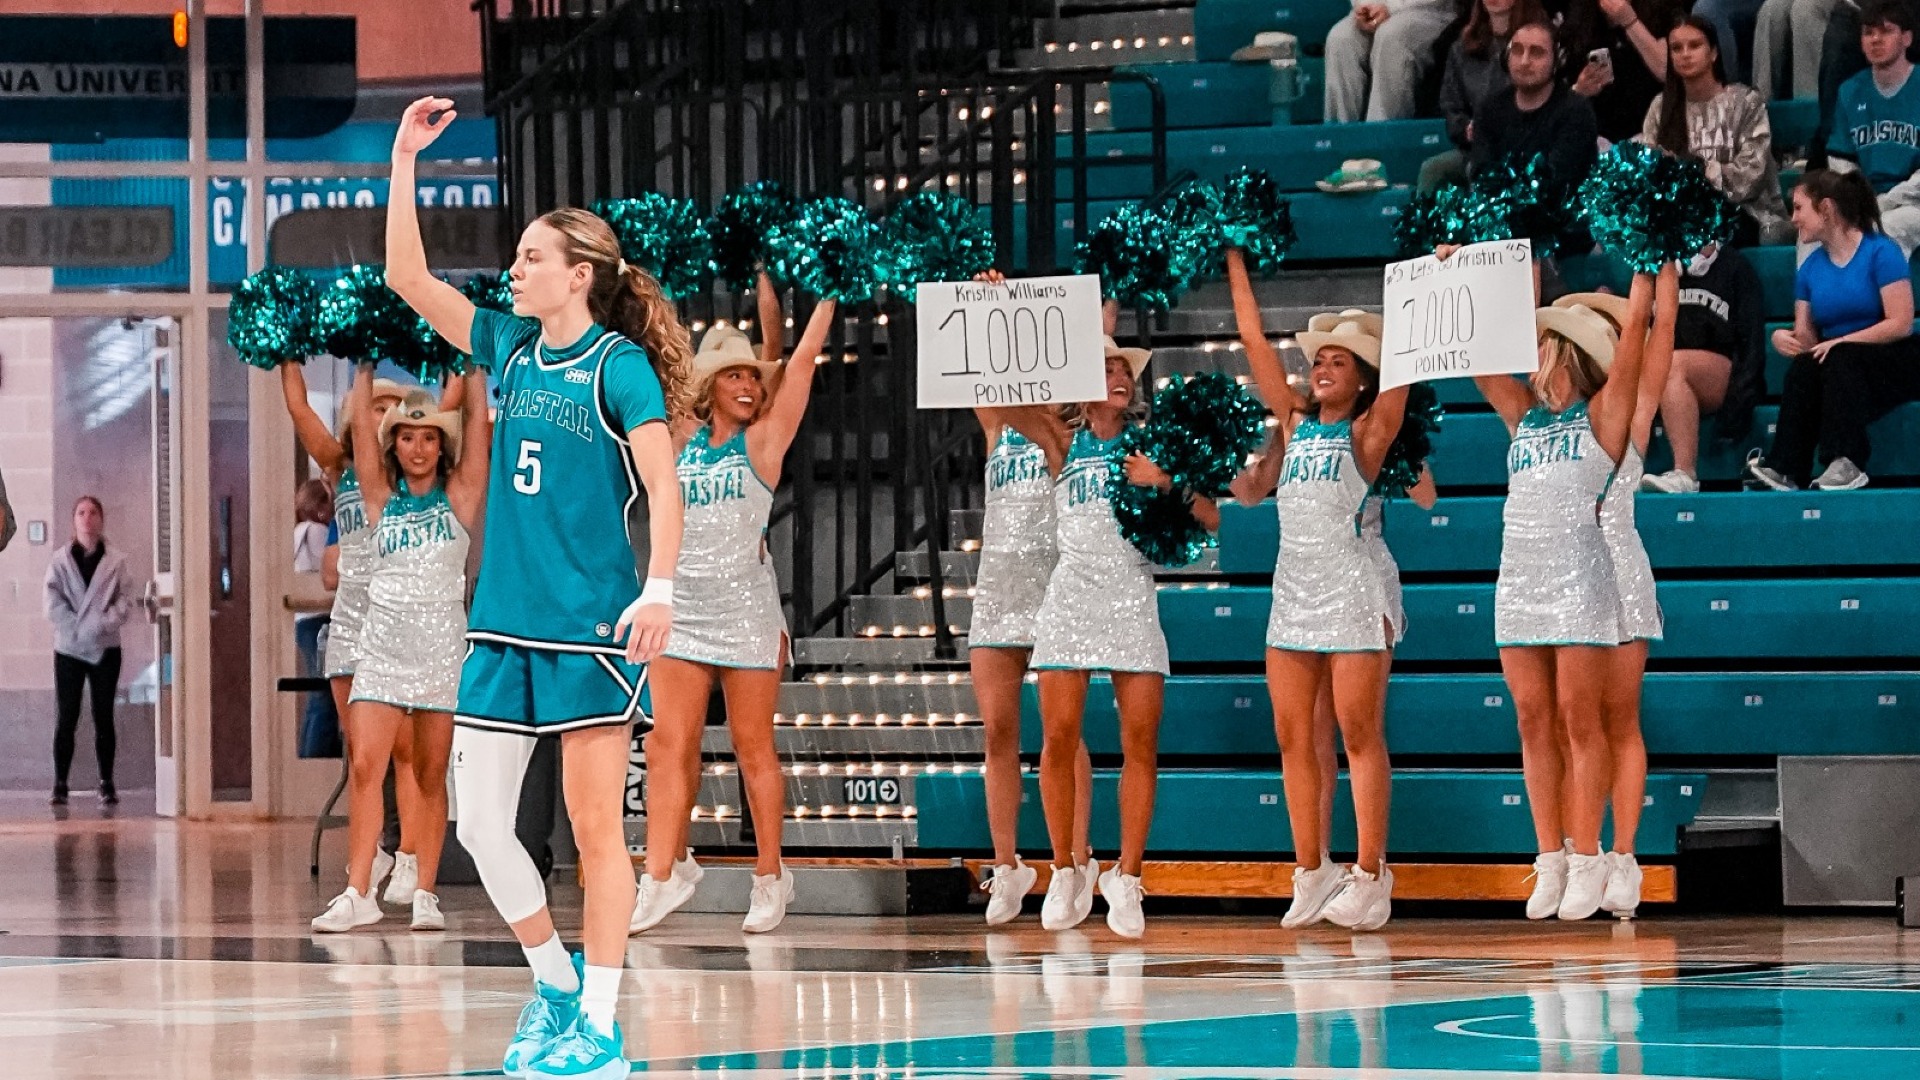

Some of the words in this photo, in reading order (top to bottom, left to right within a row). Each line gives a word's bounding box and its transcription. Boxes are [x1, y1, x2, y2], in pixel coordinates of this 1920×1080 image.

[1457, 248, 1504, 269] Kristin
[955, 284, 999, 302] Kristin
[1004, 281, 1067, 300] Williams
[939, 305, 1068, 377] 1,000
[1415, 350, 1471, 375] POINTS
[974, 380, 1052, 403] POINTS
[513, 439, 542, 496] 5
[378, 514, 456, 559] COASTAL
[845, 780, 877, 801] 101
